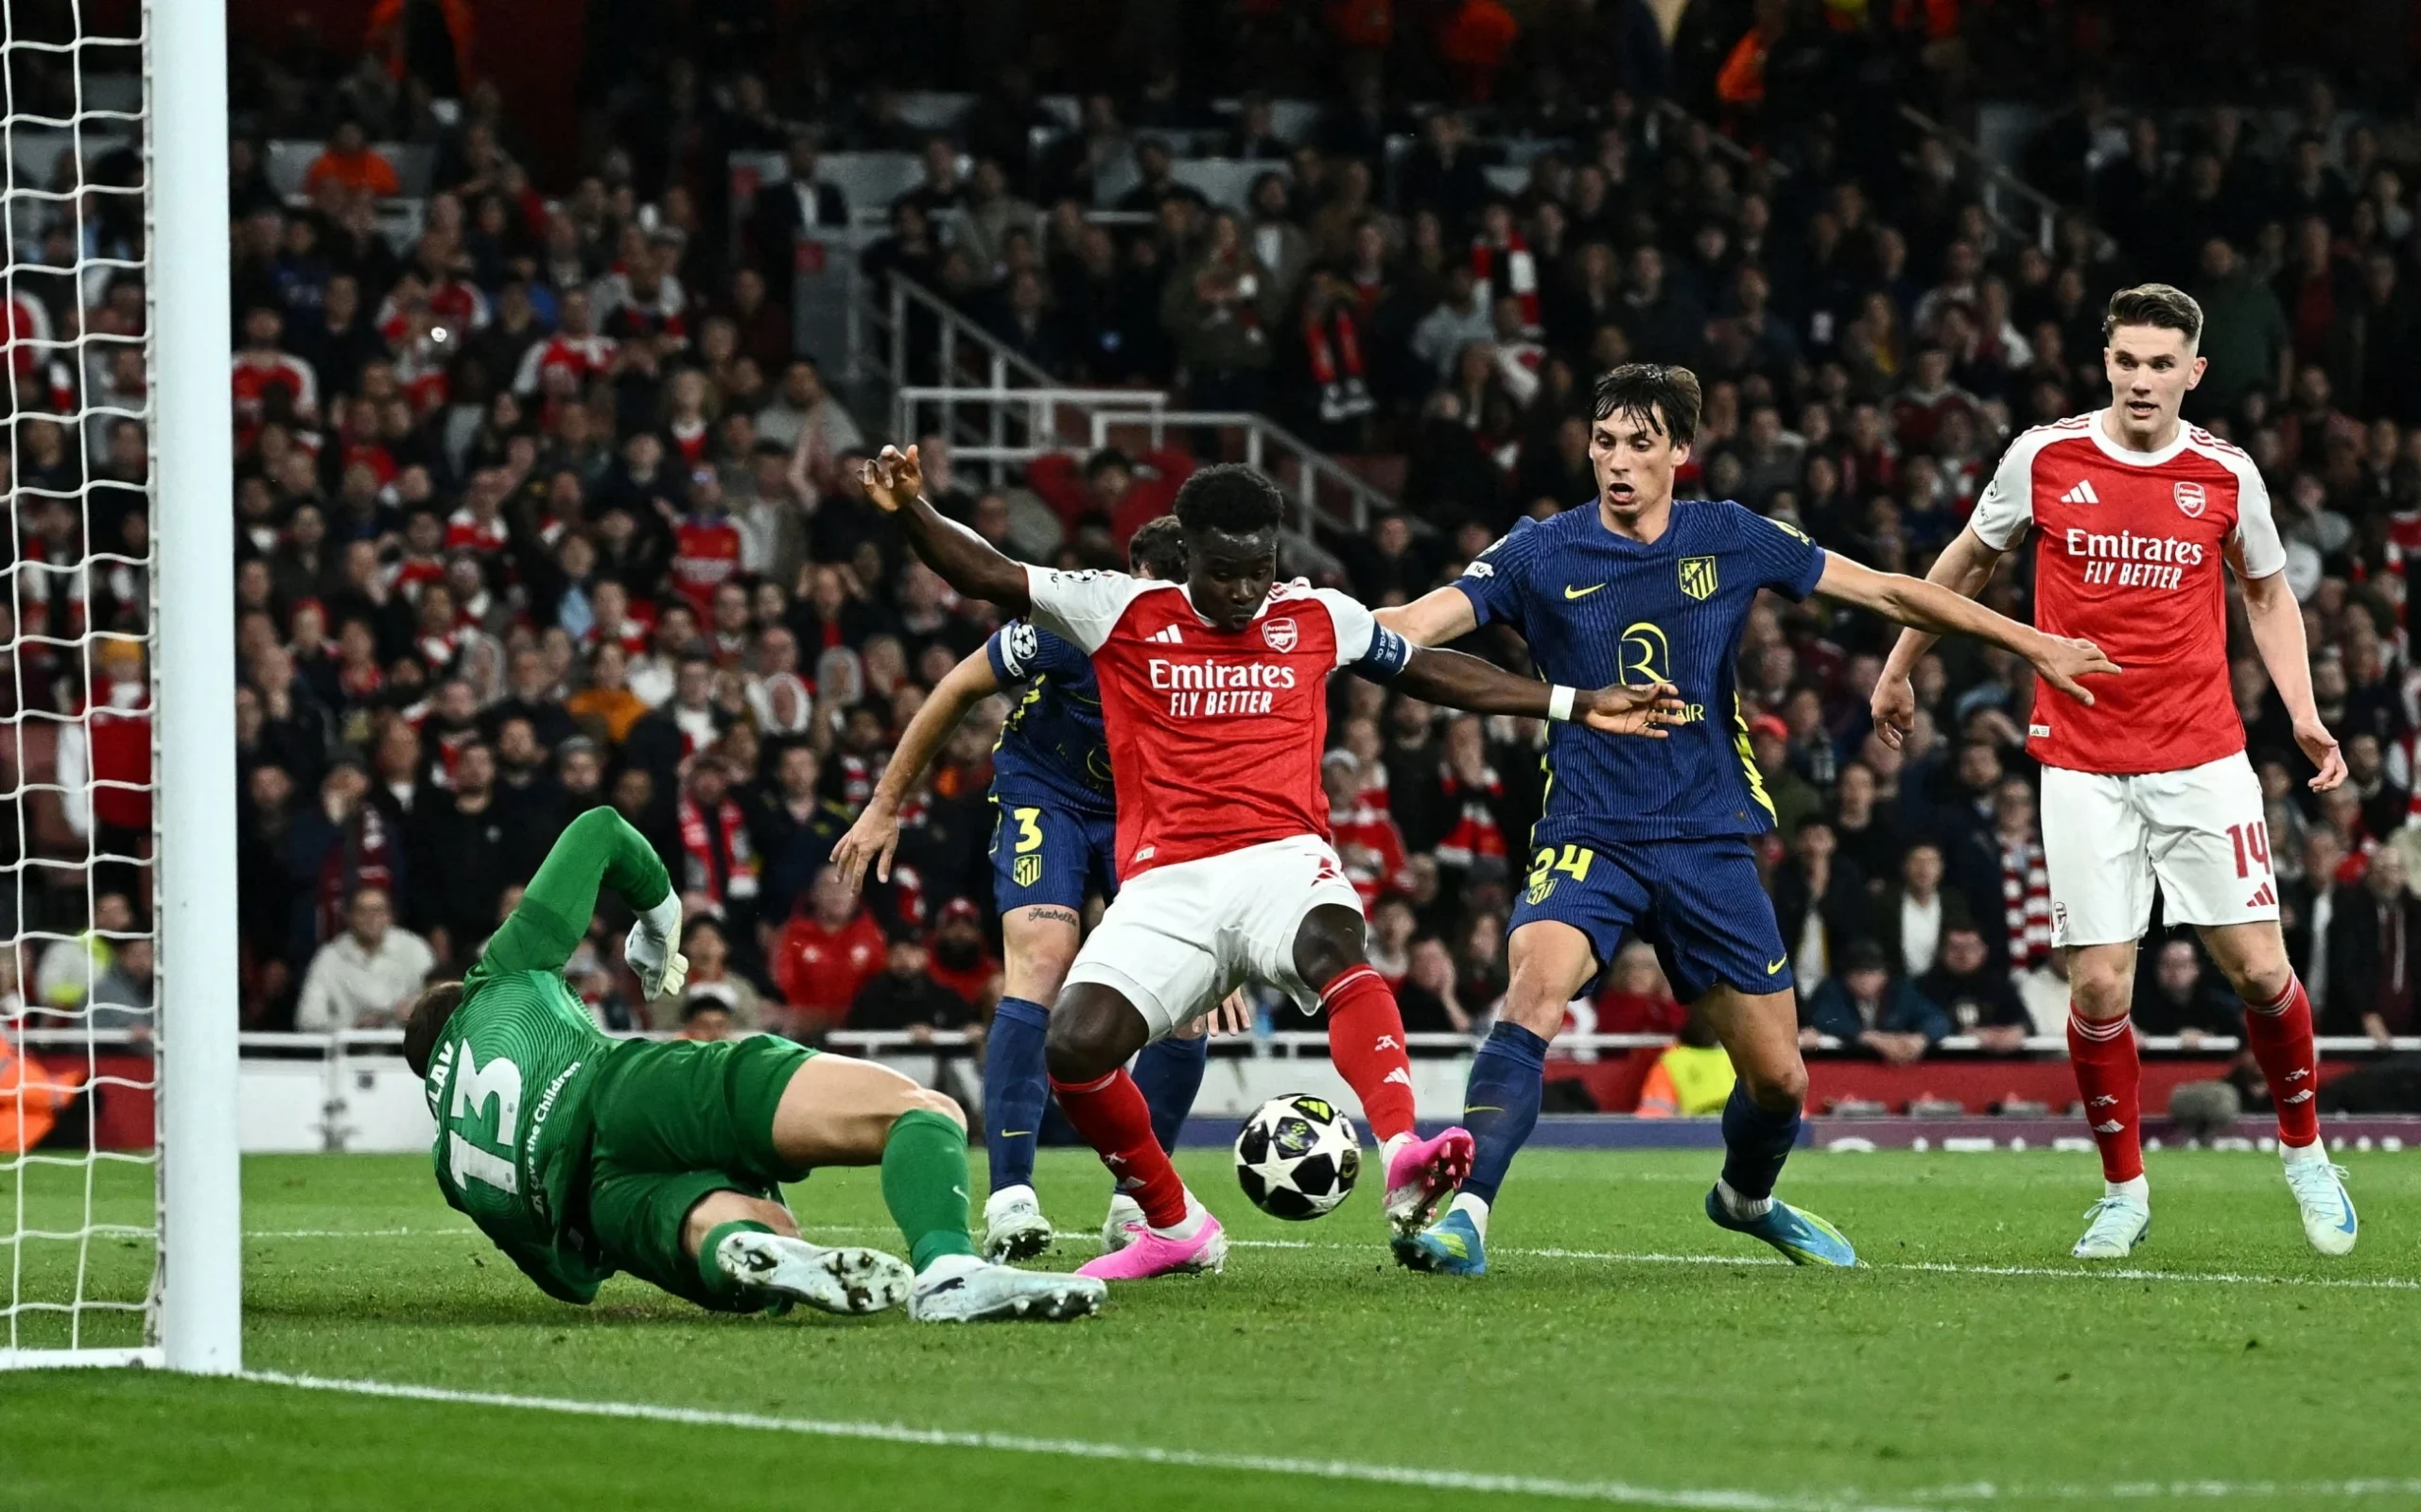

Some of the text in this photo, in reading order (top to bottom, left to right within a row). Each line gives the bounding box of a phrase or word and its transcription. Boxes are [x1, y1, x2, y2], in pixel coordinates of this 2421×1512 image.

[2066, 528, 2203, 565] Emirates
[2083, 561, 2183, 590] FLY BETTER
[1148, 658, 1296, 689] Emirates
[1170, 690, 1273, 717] FLY BETTER
[1014, 808, 1043, 853] 3
[2225, 821, 2272, 879] 14
[1529, 843, 1594, 889] 24
[533, 1061, 582, 1123] Children
[449, 1036, 522, 1195] 13
[527, 1124, 541, 1153] the
